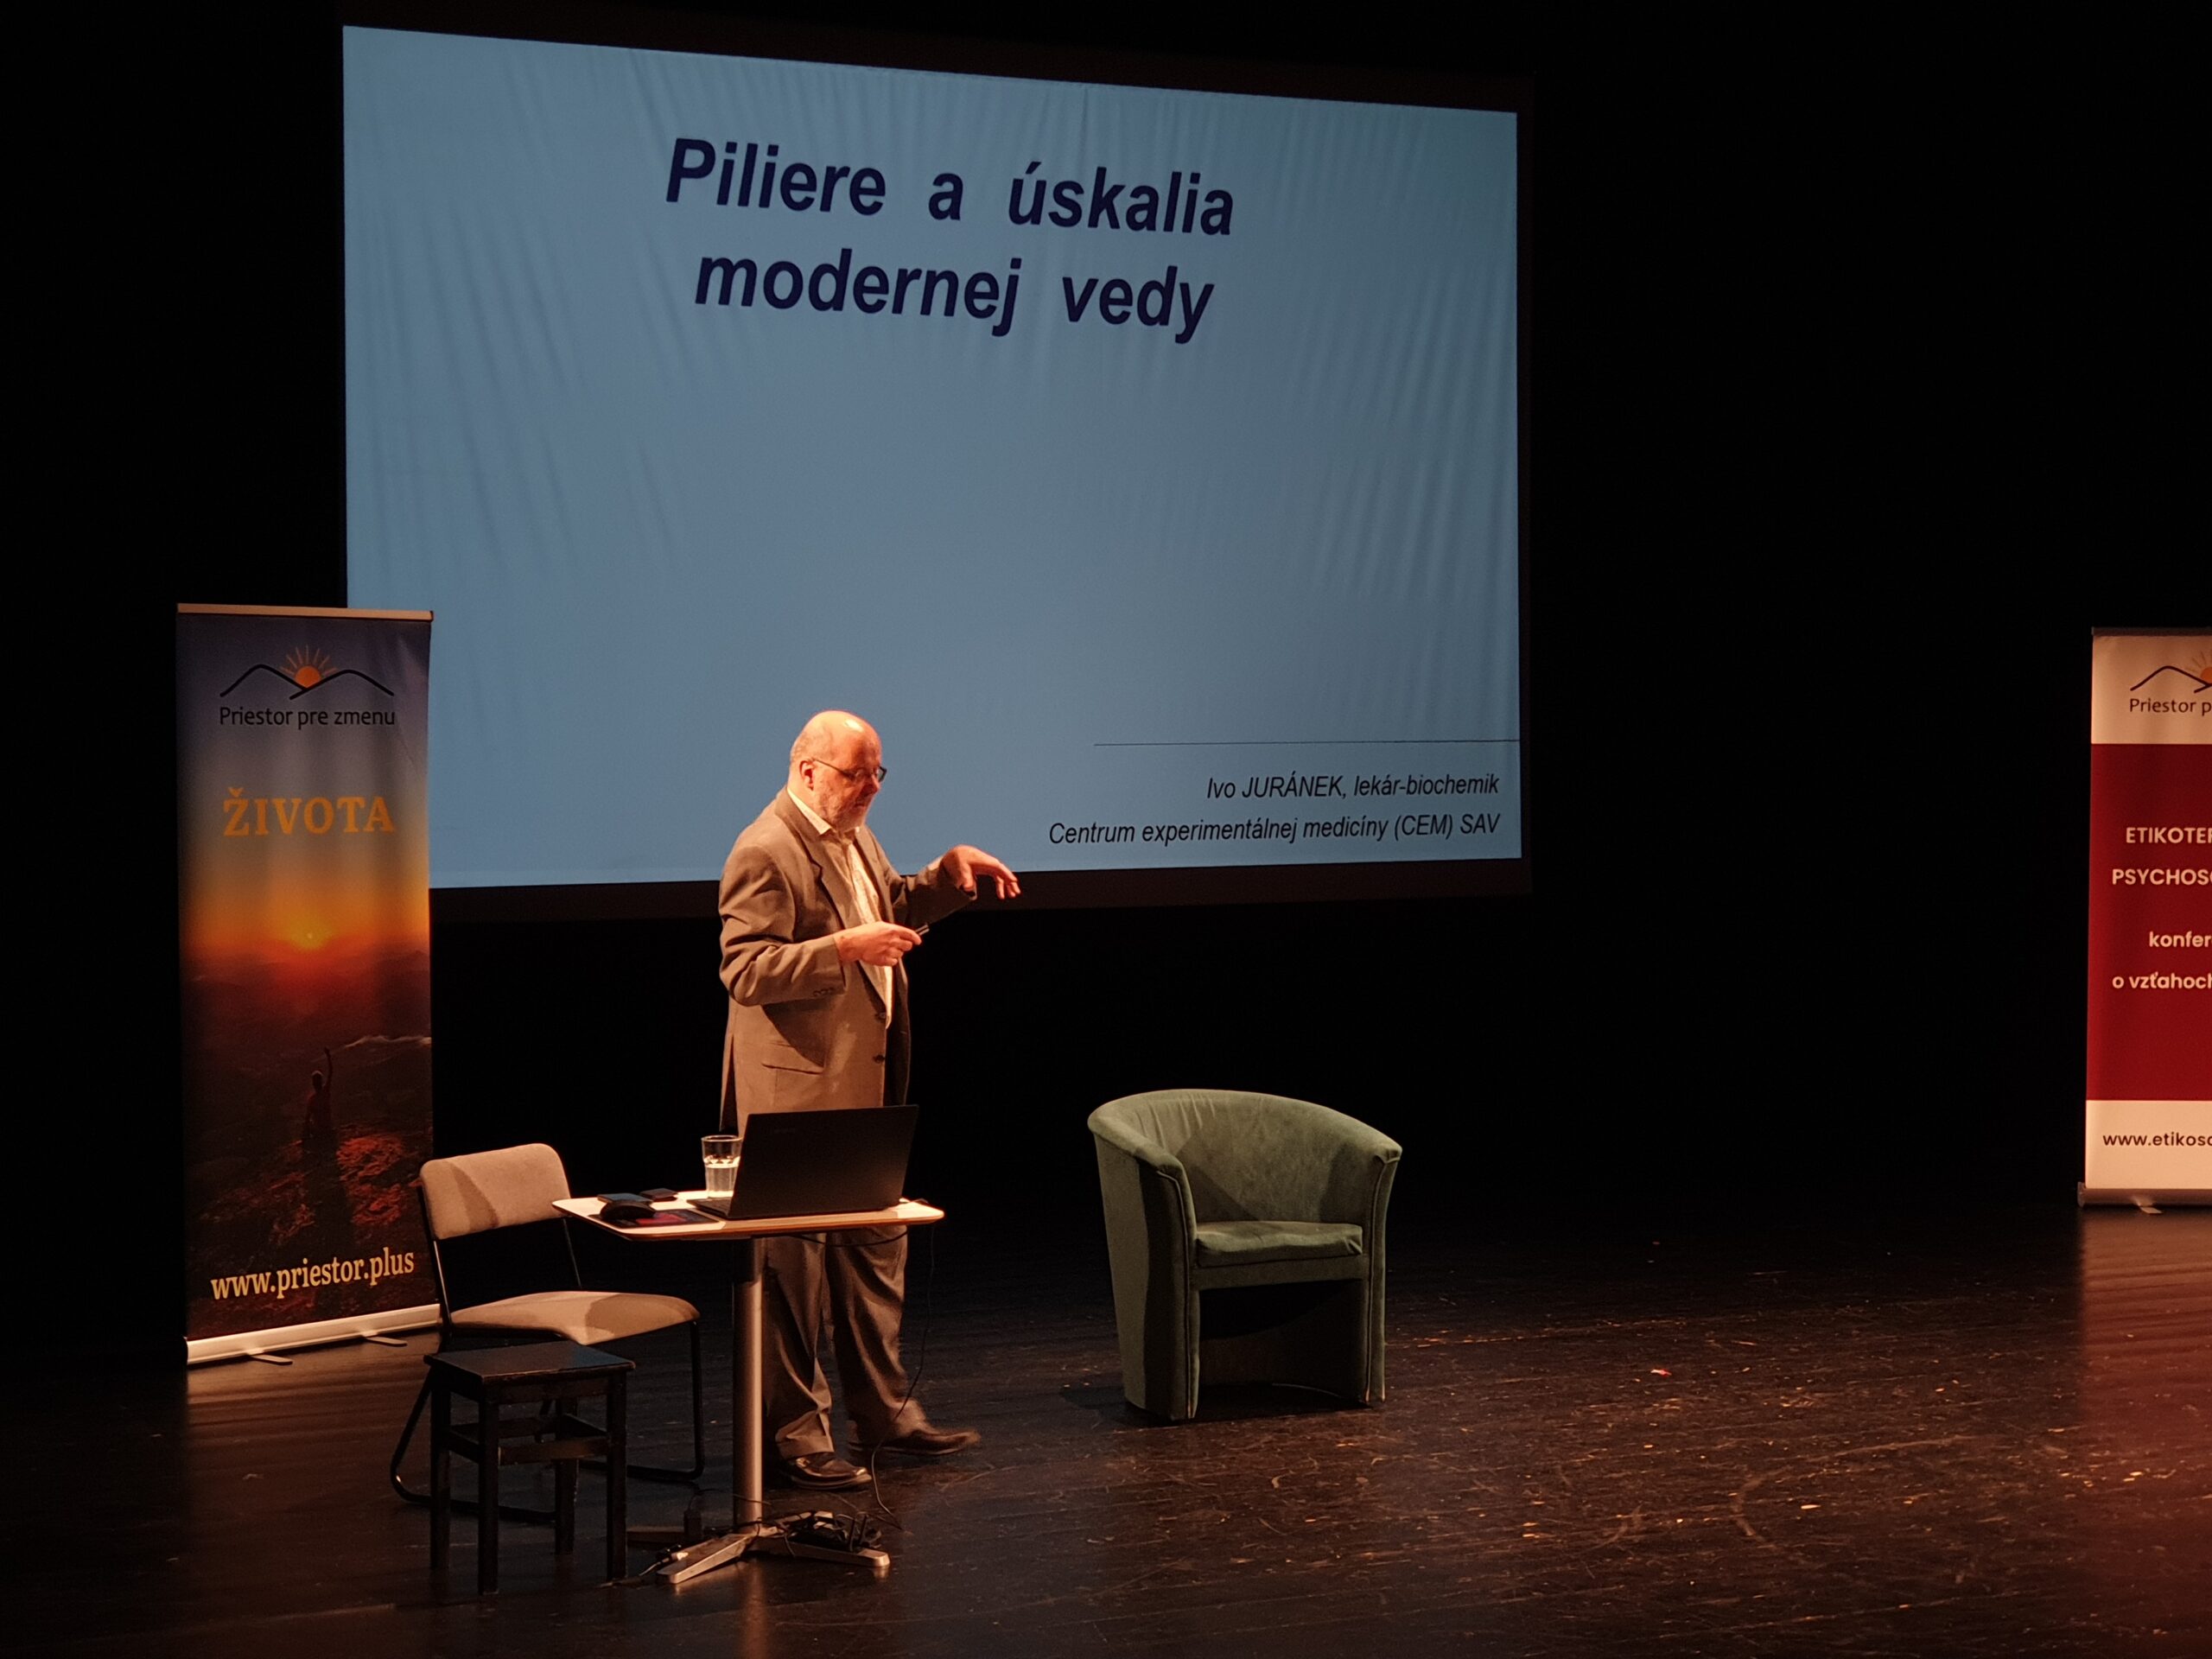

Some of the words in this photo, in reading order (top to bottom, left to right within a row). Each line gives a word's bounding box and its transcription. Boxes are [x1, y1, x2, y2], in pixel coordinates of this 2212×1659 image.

[665, 137, 887, 216] Piliere
[928, 173, 963, 220] a
[1008, 161, 1234, 236] úskalia
[695, 247, 1022, 337] modernej
[1062, 264, 1215, 345] vedy
[219, 706, 294, 726] Priestor
[297, 710, 328, 730] pre
[334, 711, 396, 726] zmenu
[2129, 697, 2197, 713] Priestor
[1207, 777, 1236, 799] Ivo
[1242, 770, 1348, 802] JURÁNEK,
[1354, 773, 1500, 797] lekár-biochemik
[223, 786, 395, 837] ŽIVOTA
[1049, 822, 1135, 844] Centrum
[1141, 817, 1298, 847] experimentálnej
[1302, 815, 1389, 842] medicíny
[1394, 814, 1453, 842] (CEM)
[1459, 813, 1501, 835] SAV
[2112, 868, 2212, 886] PSYCHOS
[2148, 931, 2212, 948] konfer
[2112, 976, 2125, 989] o
[210, 1246, 415, 1300] www.priestor.plus
